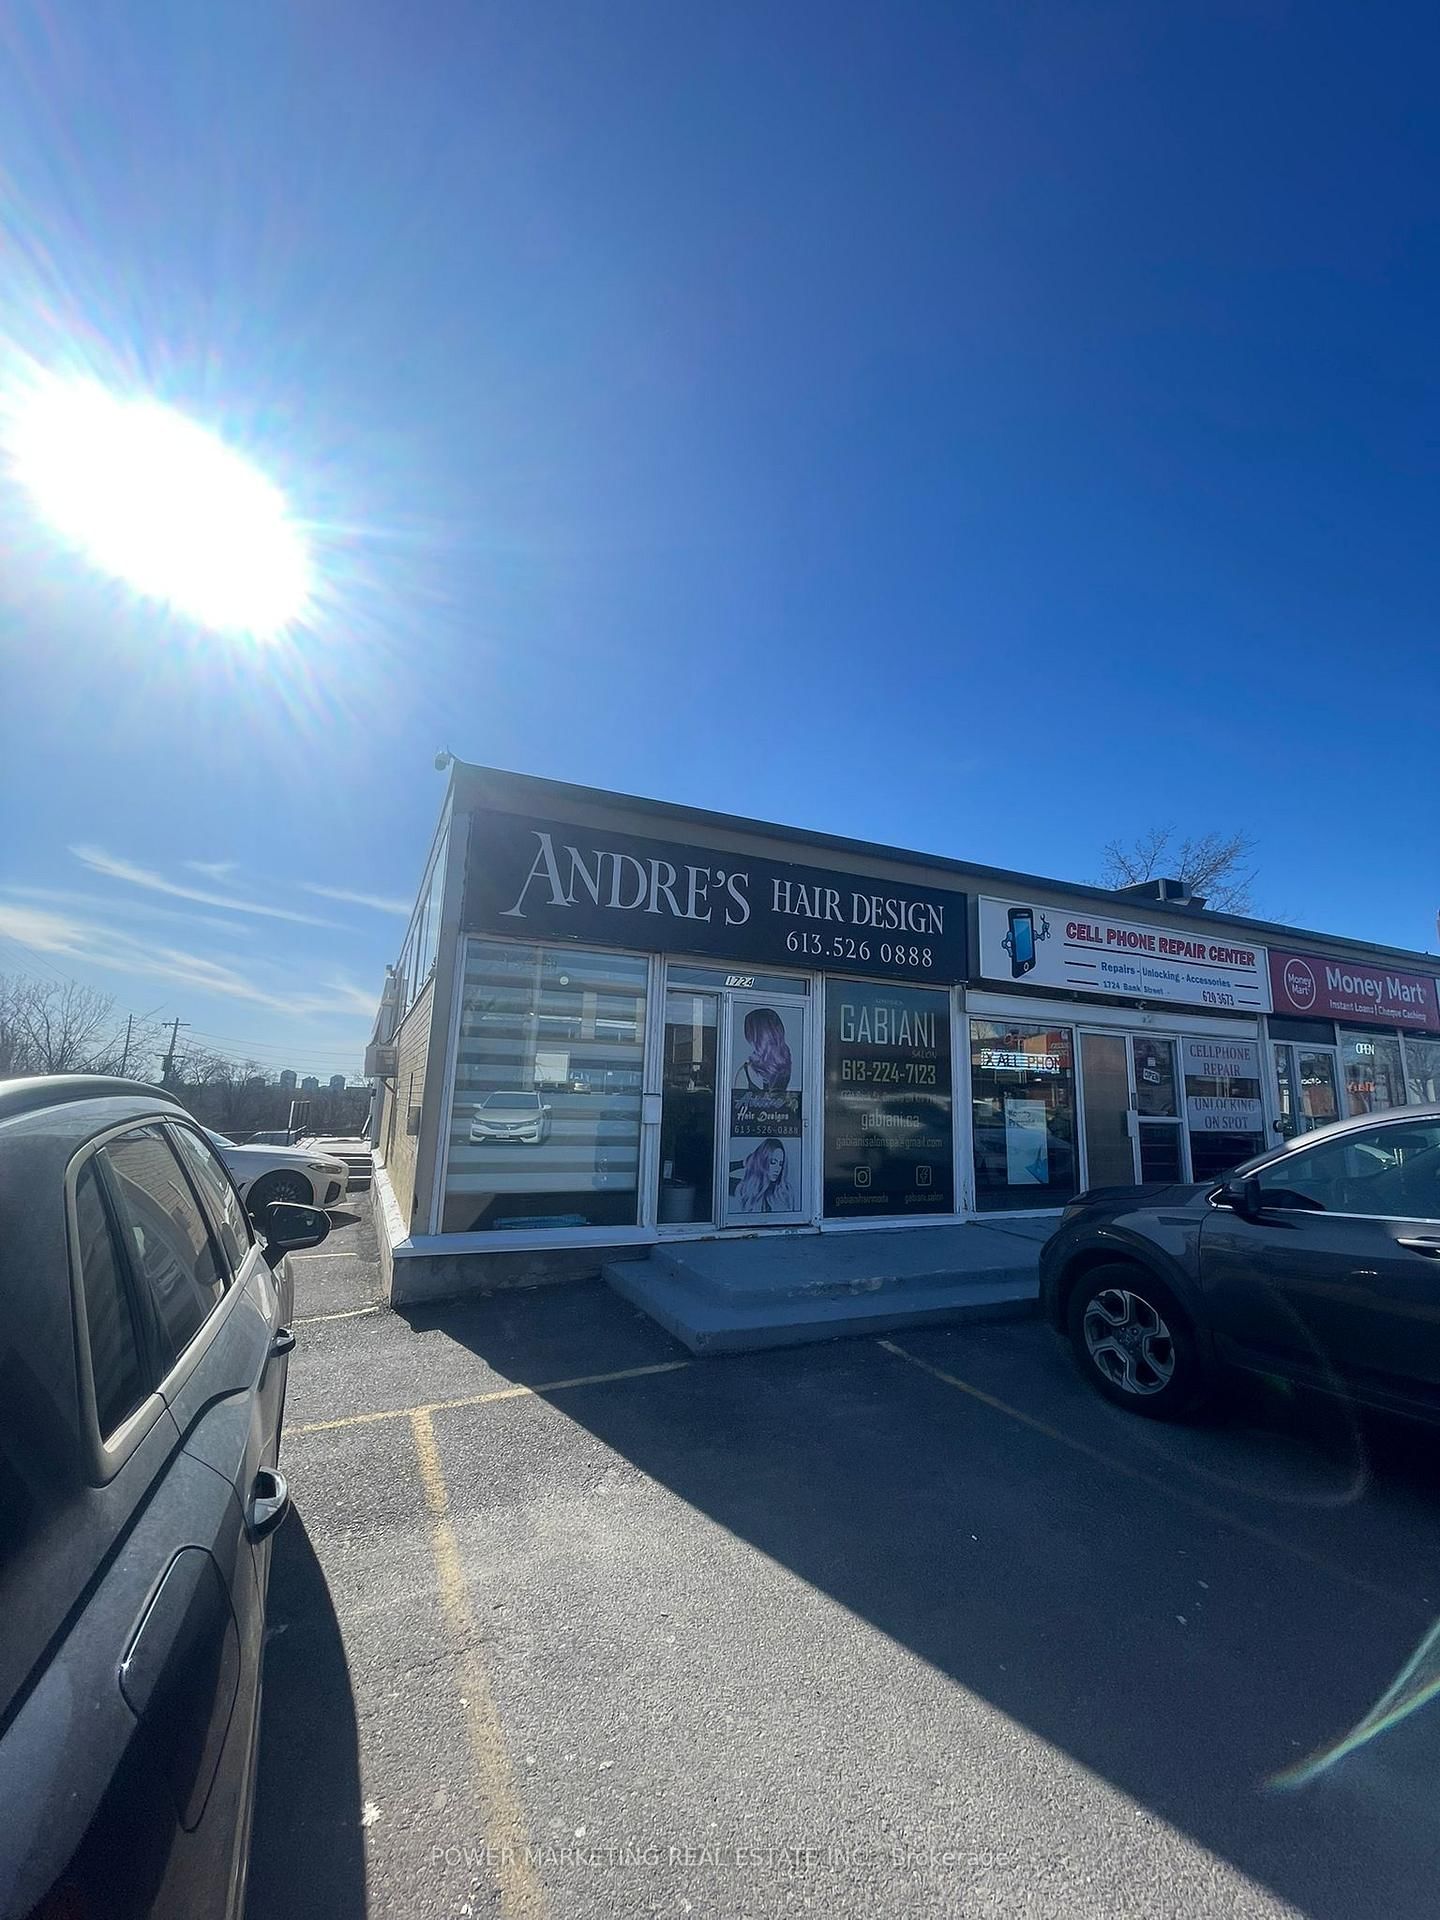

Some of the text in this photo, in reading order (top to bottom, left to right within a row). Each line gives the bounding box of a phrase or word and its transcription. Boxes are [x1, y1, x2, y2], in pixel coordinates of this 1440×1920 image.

[500, 831, 945, 935] ANDRE'S HAIR DESIGN
[786, 931, 934, 968] 613.526 0888
[1066, 922, 1256, 967] CELL PHONE REPAIR CENTER
[726, 976, 754, 987] 1724
[1101, 961, 1136, 977] Repairs
[1142, 966, 1181, 983] Unlocking
[1186, 972, 1231, 989] Accessories
[1287, 973, 1312, 988] Money
[1291, 984, 1310, 996] Mart
[1325, 966, 1425, 1004] Money Mart
[1329, 999, 1354, 1012] Instant
[840, 1004, 936, 1048] GABIANI
[1189, 1044, 1251, 1061] CELLPHONE
[1355, 1042, 1375, 1055] OPEN
[842, 1059, 936, 1085] 613-224-7123
[1203, 1062, 1241, 1077] REPAIR
[861, 1108, 920, 1130] gabiani.ca
[1204, 1115, 1248, 1129] ON SPOT
